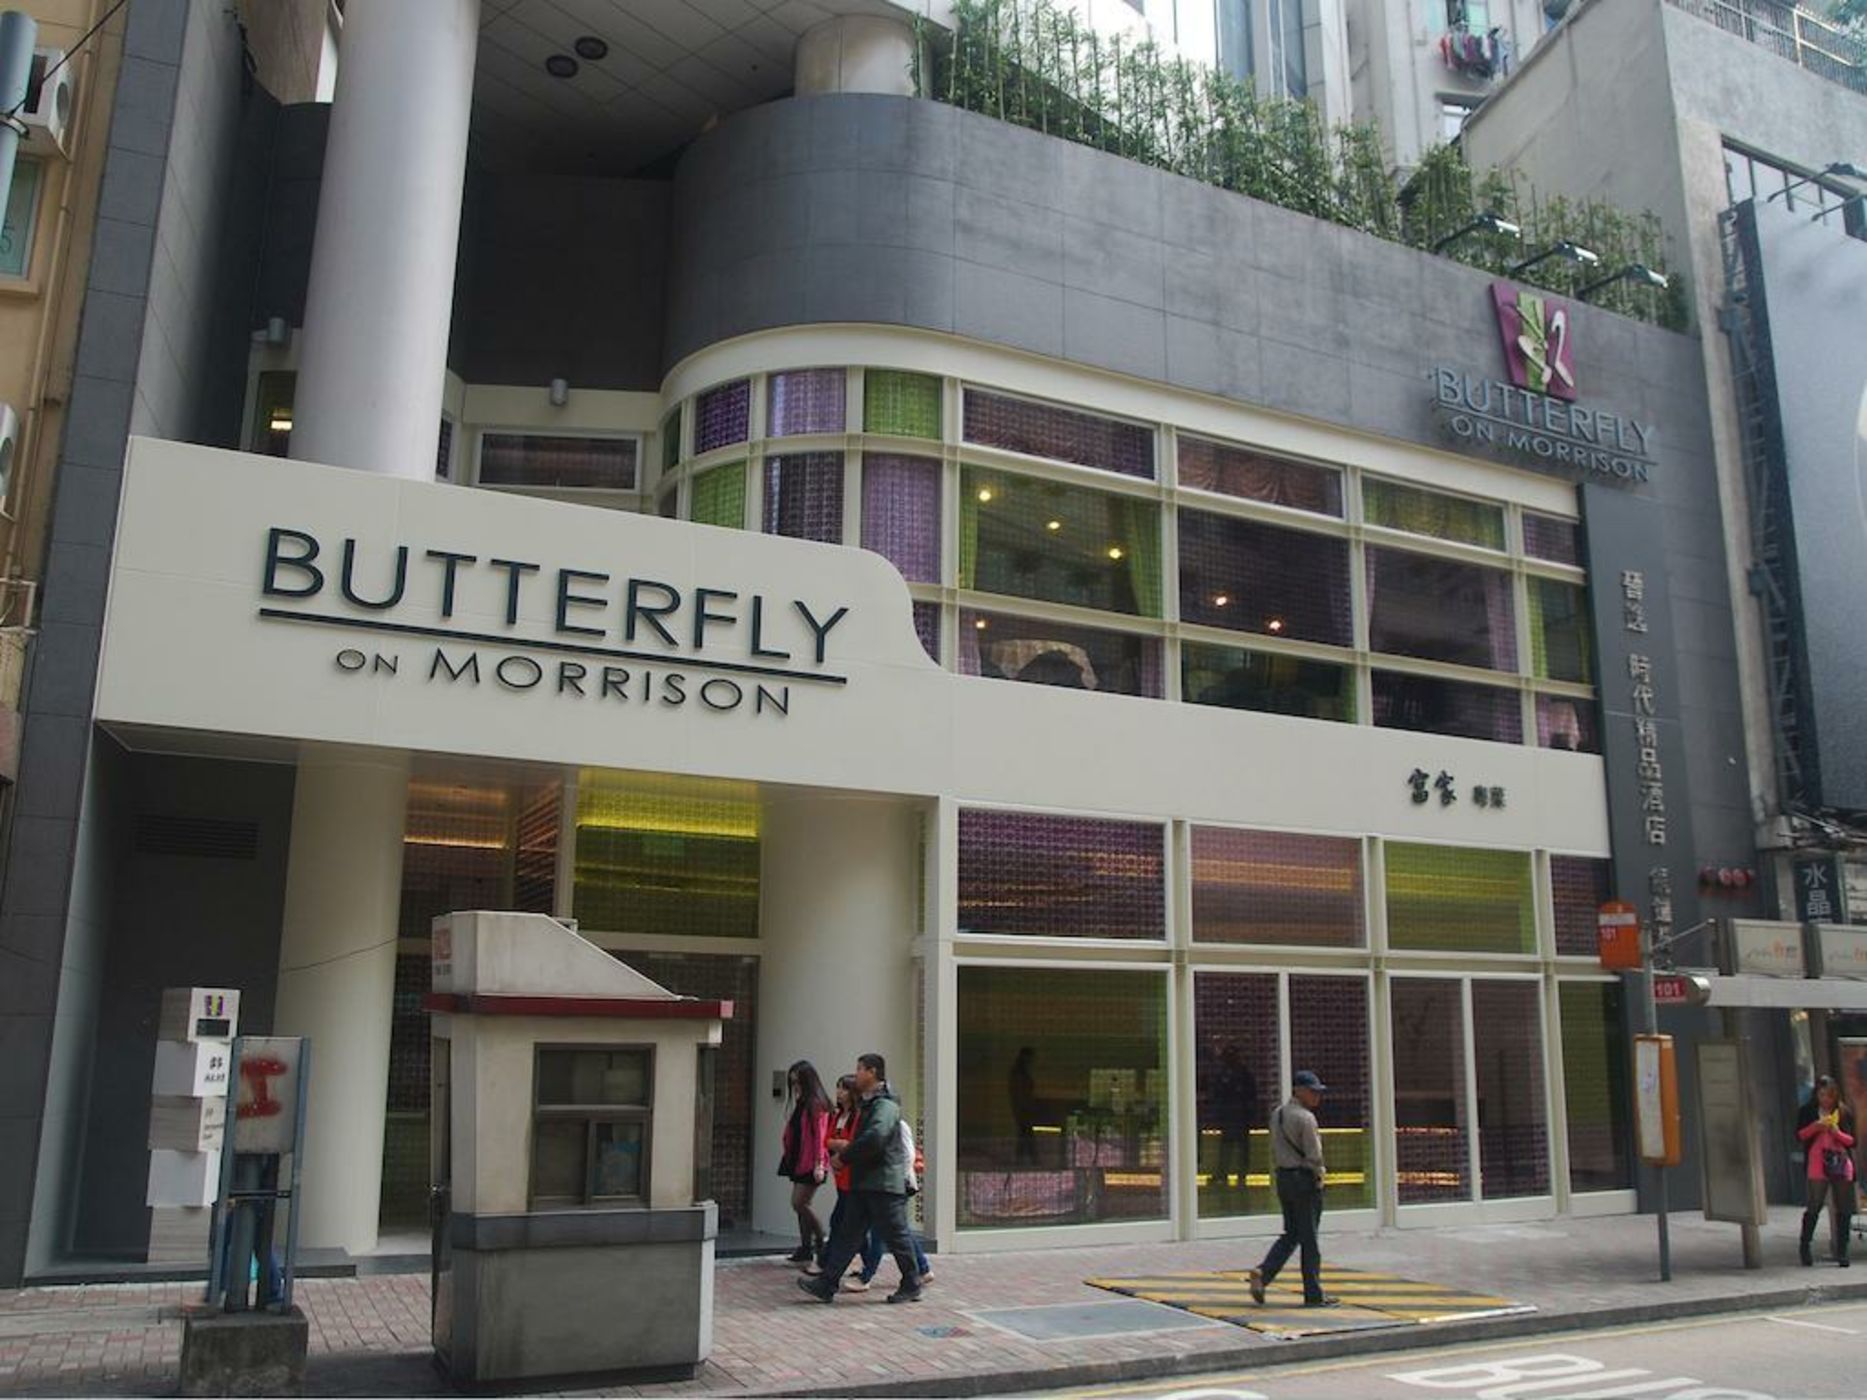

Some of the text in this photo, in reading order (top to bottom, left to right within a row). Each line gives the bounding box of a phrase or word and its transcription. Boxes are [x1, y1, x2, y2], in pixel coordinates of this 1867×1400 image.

[1434, 367, 1655, 455] BUTTERFLY
[1451, 415, 1651, 483] ON MORRISON
[261, 527, 850, 664] BUTTERFLY
[335, 647, 791, 716] ON MORRISON
[1630, 653, 1667, 846] 時代精品酒店
[1802, 862, 1833, 924] 水晶
[1655, 981, 1681, 997] 101
